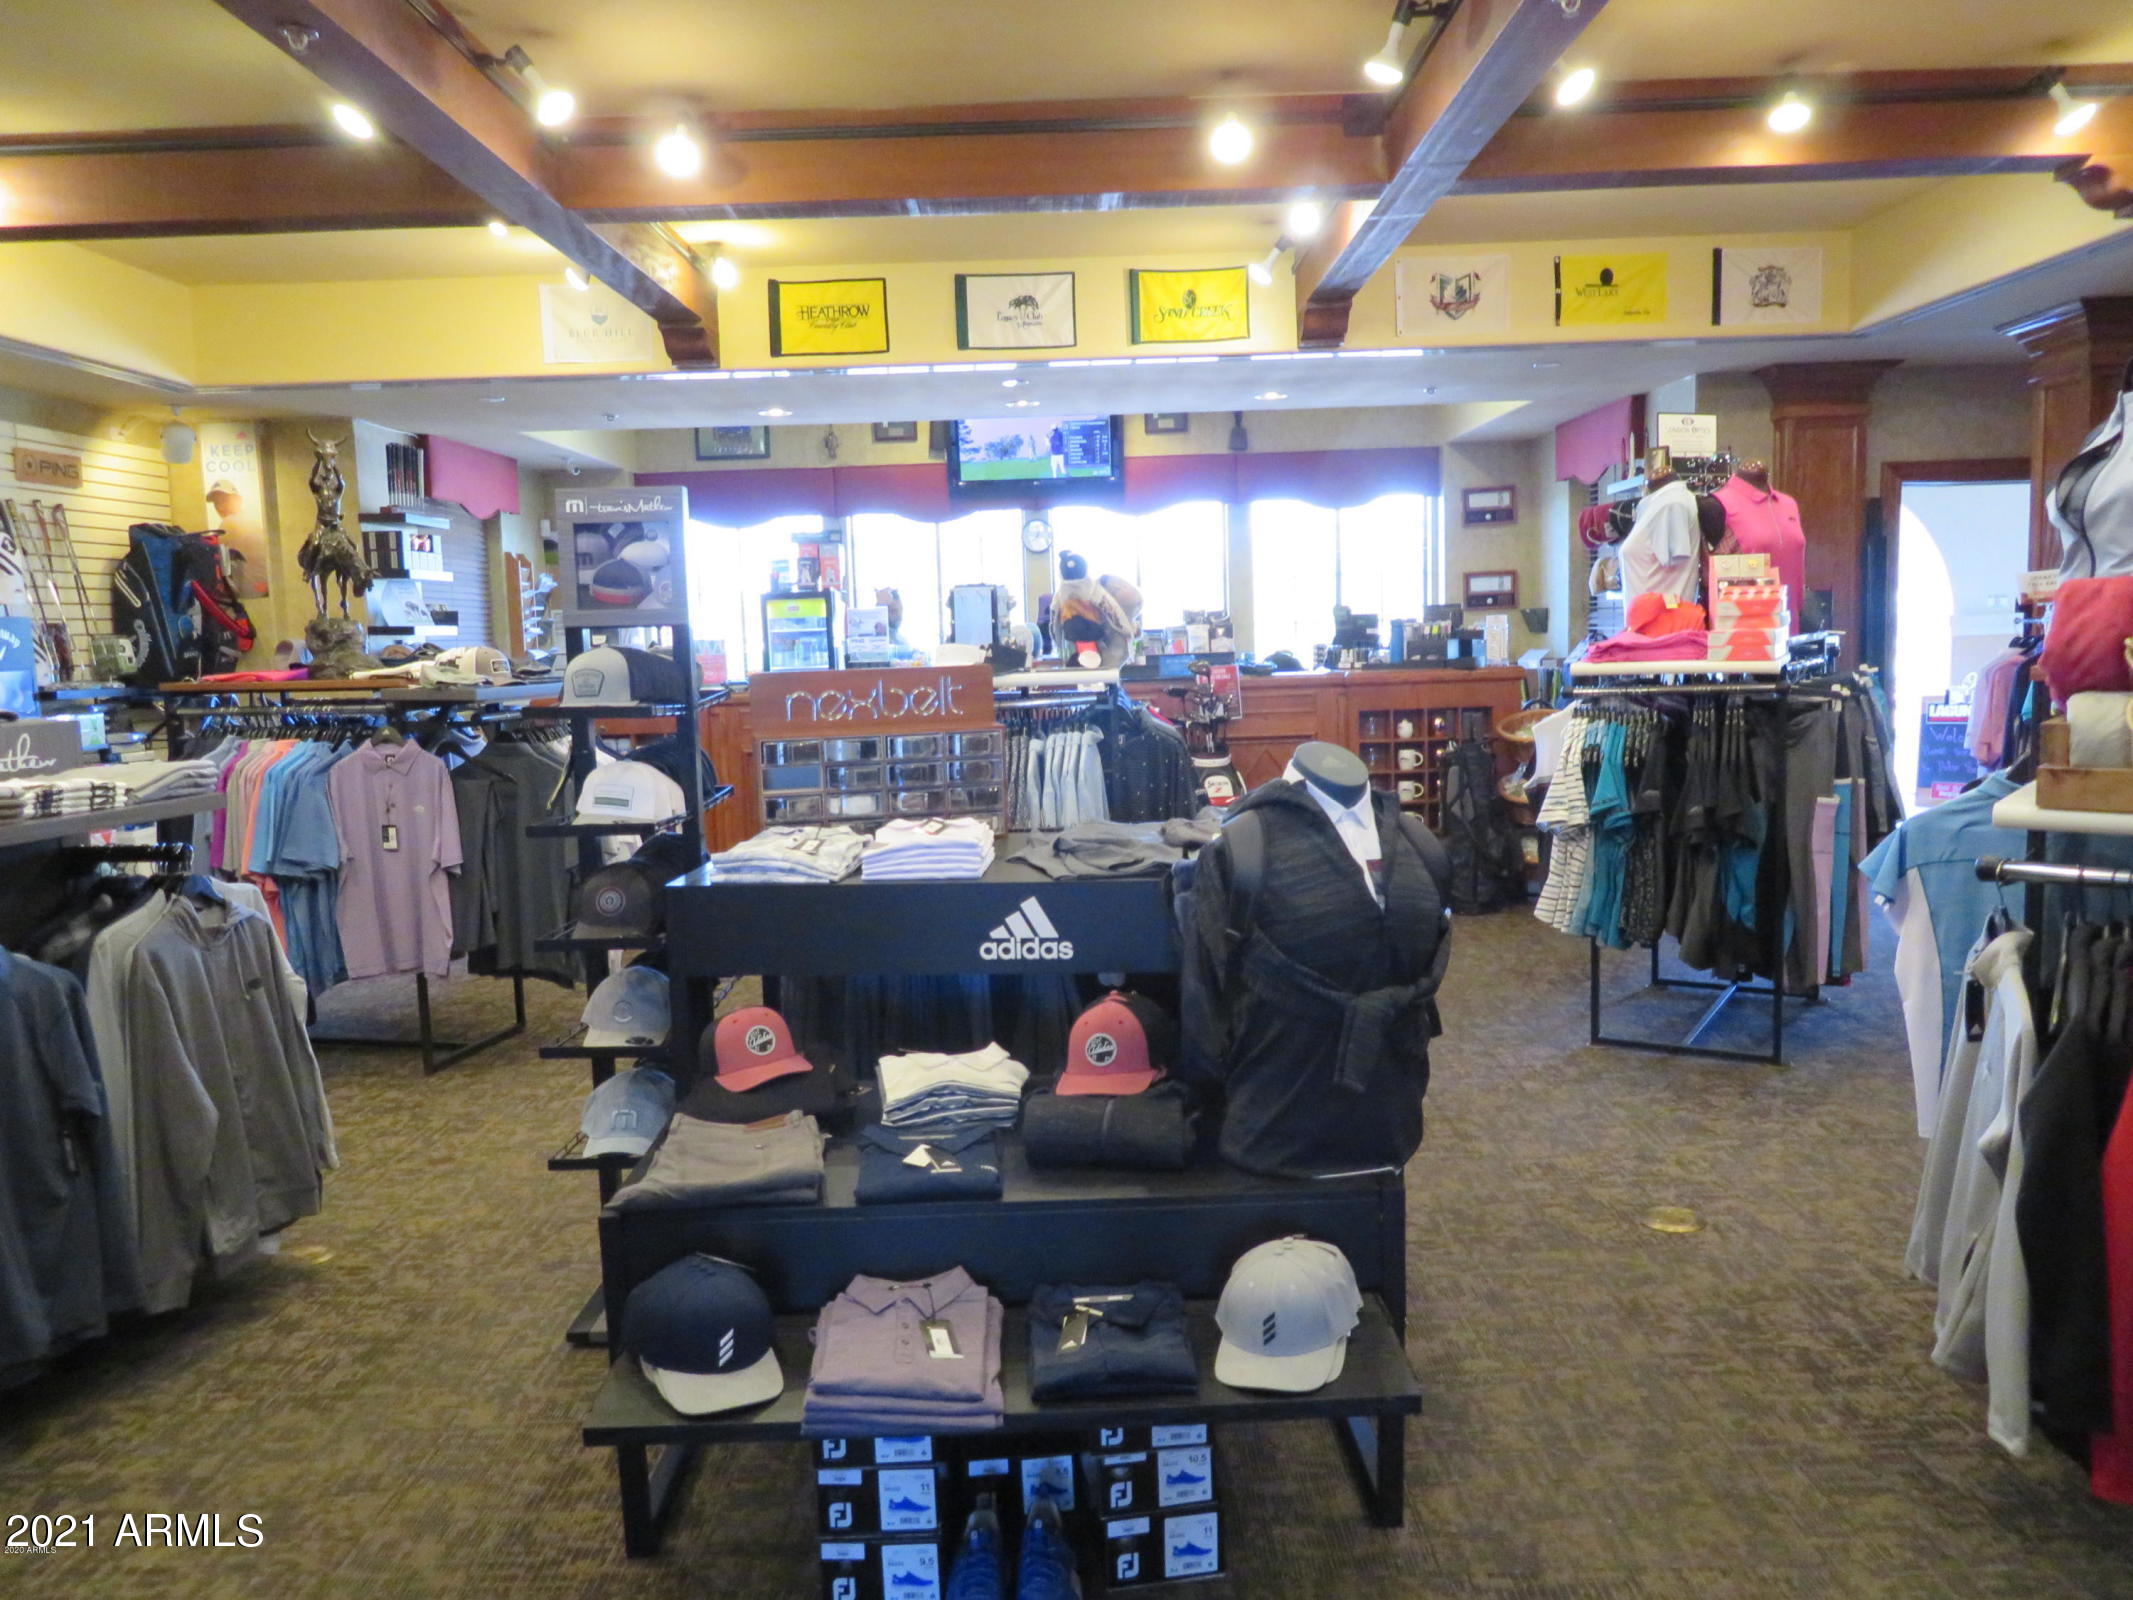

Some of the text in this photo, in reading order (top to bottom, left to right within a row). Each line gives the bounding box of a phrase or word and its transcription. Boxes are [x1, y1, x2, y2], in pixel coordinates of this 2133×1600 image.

[796, 304, 870, 320] HEATHROW
[210, 444, 255, 457] KEEP
[39, 462, 80, 480] PING
[206, 459, 255, 473] COOL
[786, 676, 964, 721] nexbelt
[979, 936, 1074, 960] adidas
[921, 1482, 931, 1491] 11
